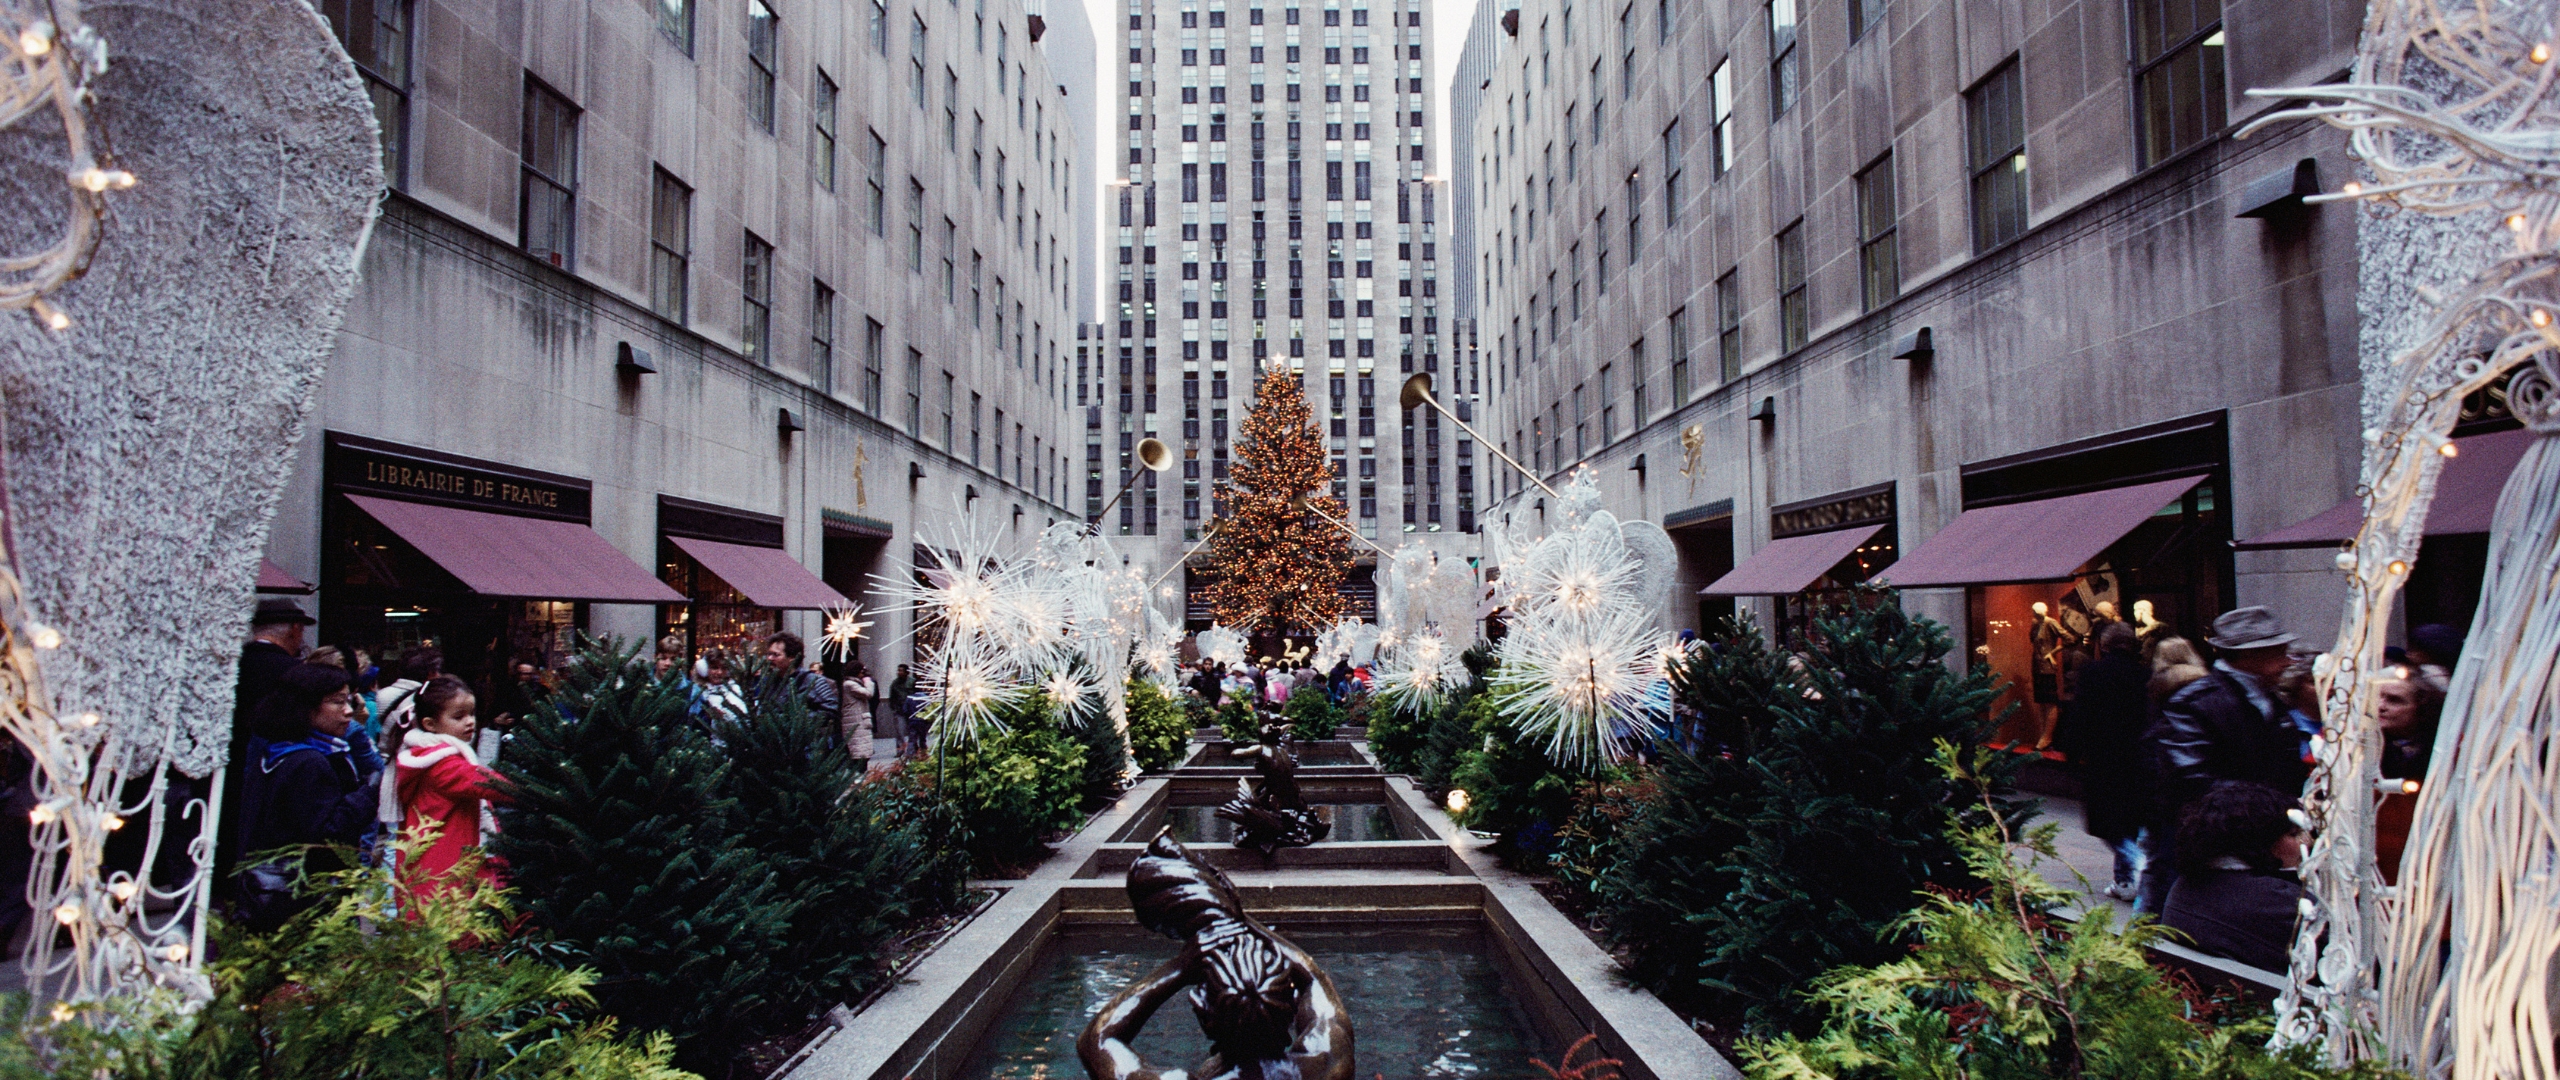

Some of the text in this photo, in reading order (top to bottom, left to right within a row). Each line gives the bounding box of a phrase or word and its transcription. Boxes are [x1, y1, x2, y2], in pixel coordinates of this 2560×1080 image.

[367, 462, 558, 508] LIBRAIRIE DE FRANCE
